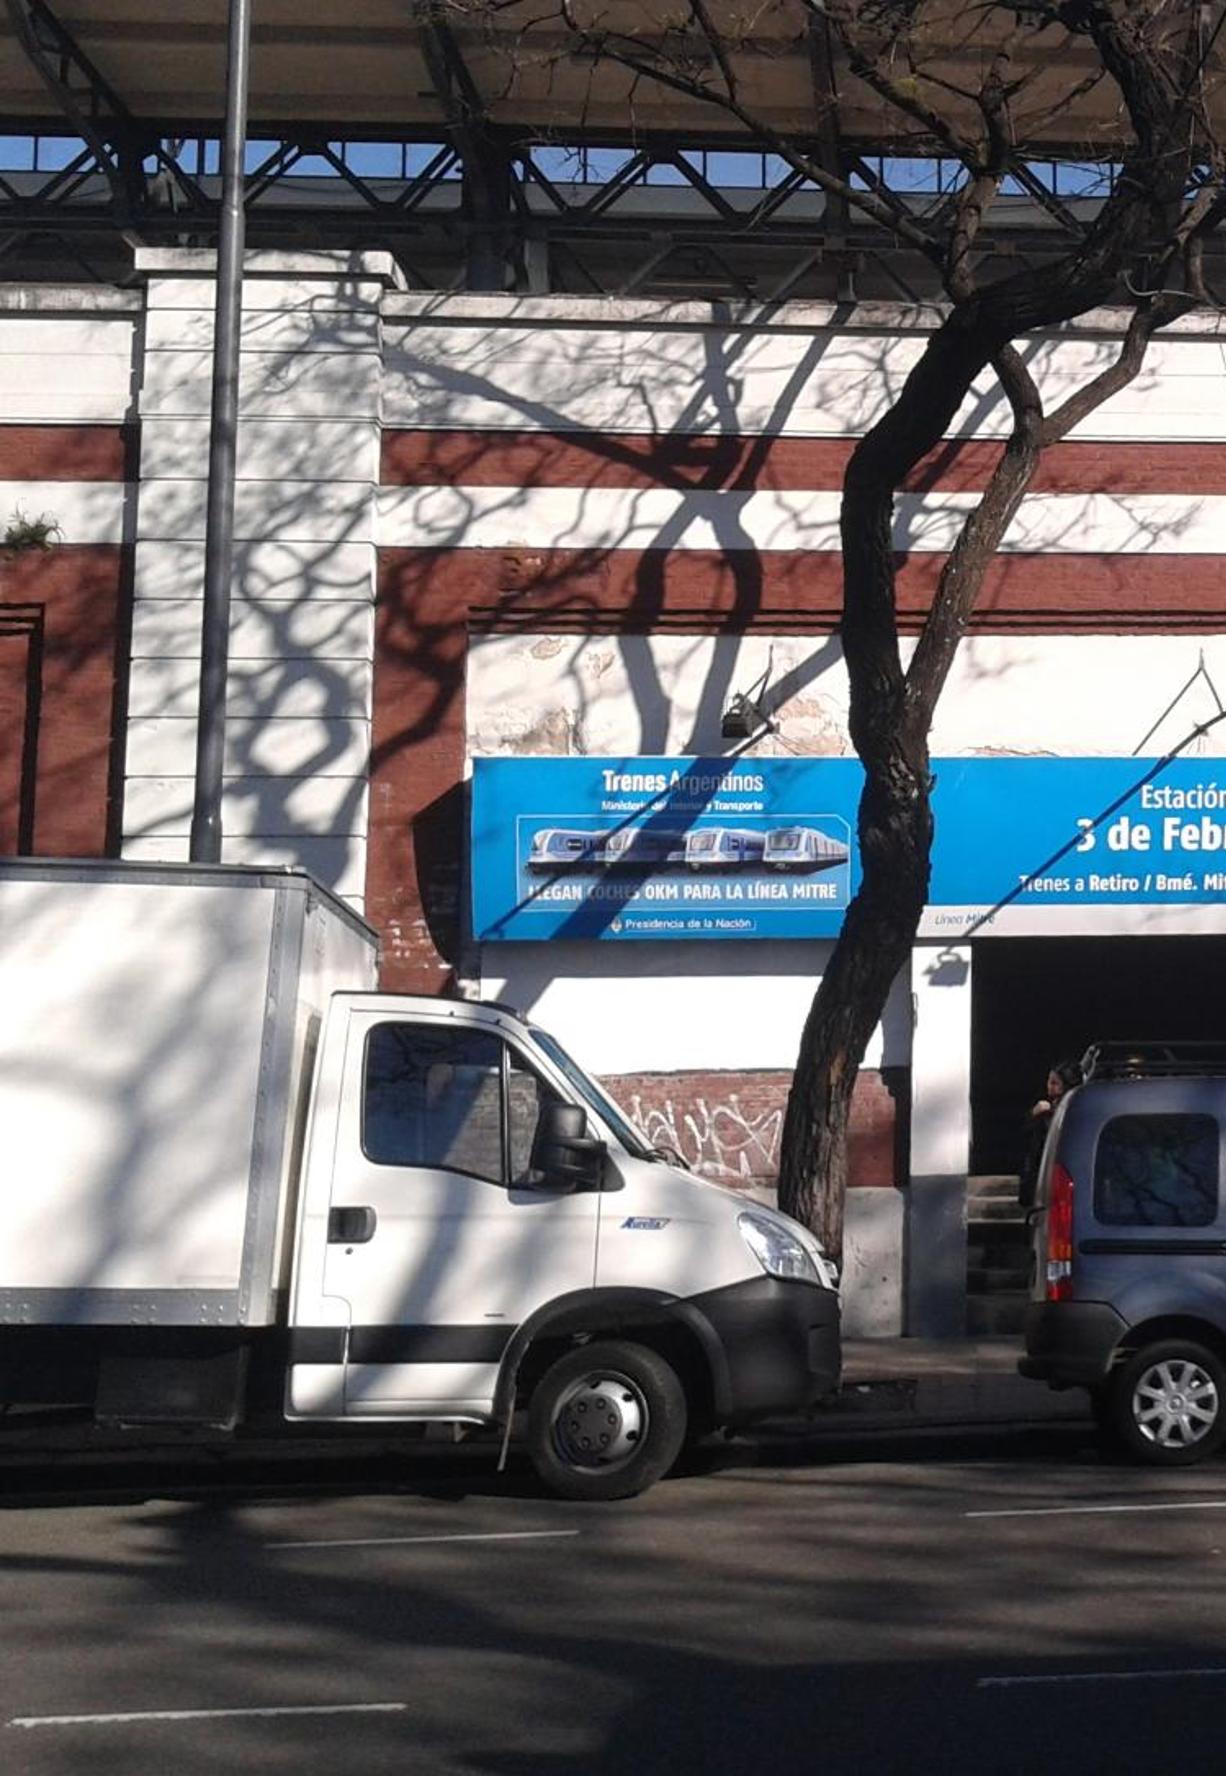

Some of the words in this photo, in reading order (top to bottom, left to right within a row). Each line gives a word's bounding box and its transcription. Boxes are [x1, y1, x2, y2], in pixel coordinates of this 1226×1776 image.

[601, 769, 666, 792] Trenes
[670, 768, 764, 796] Argentinos
[714, 800, 764, 812] Transporte
[1076, 818, 1096, 852] 3
[1107, 816, 1150, 851] de
[683, 883, 722, 900] PARA
[725, 883, 746, 899] LA
[748, 880, 789, 899] LÍNEA
[792, 882, 837, 899] MITRE
[1018, 874, 1070, 892] Trenes
[1074, 878, 1085, 892] a
[1089, 873, 1140, 892] Retiro
[1143, 874, 1152, 892] /
[1155, 872, 1198, 892] Bmé.
[625, 918, 685, 929] Presidencia
[687, 919, 701, 929] de
[703, 918, 714, 929] la
[715, 917, 752, 929] Nación
